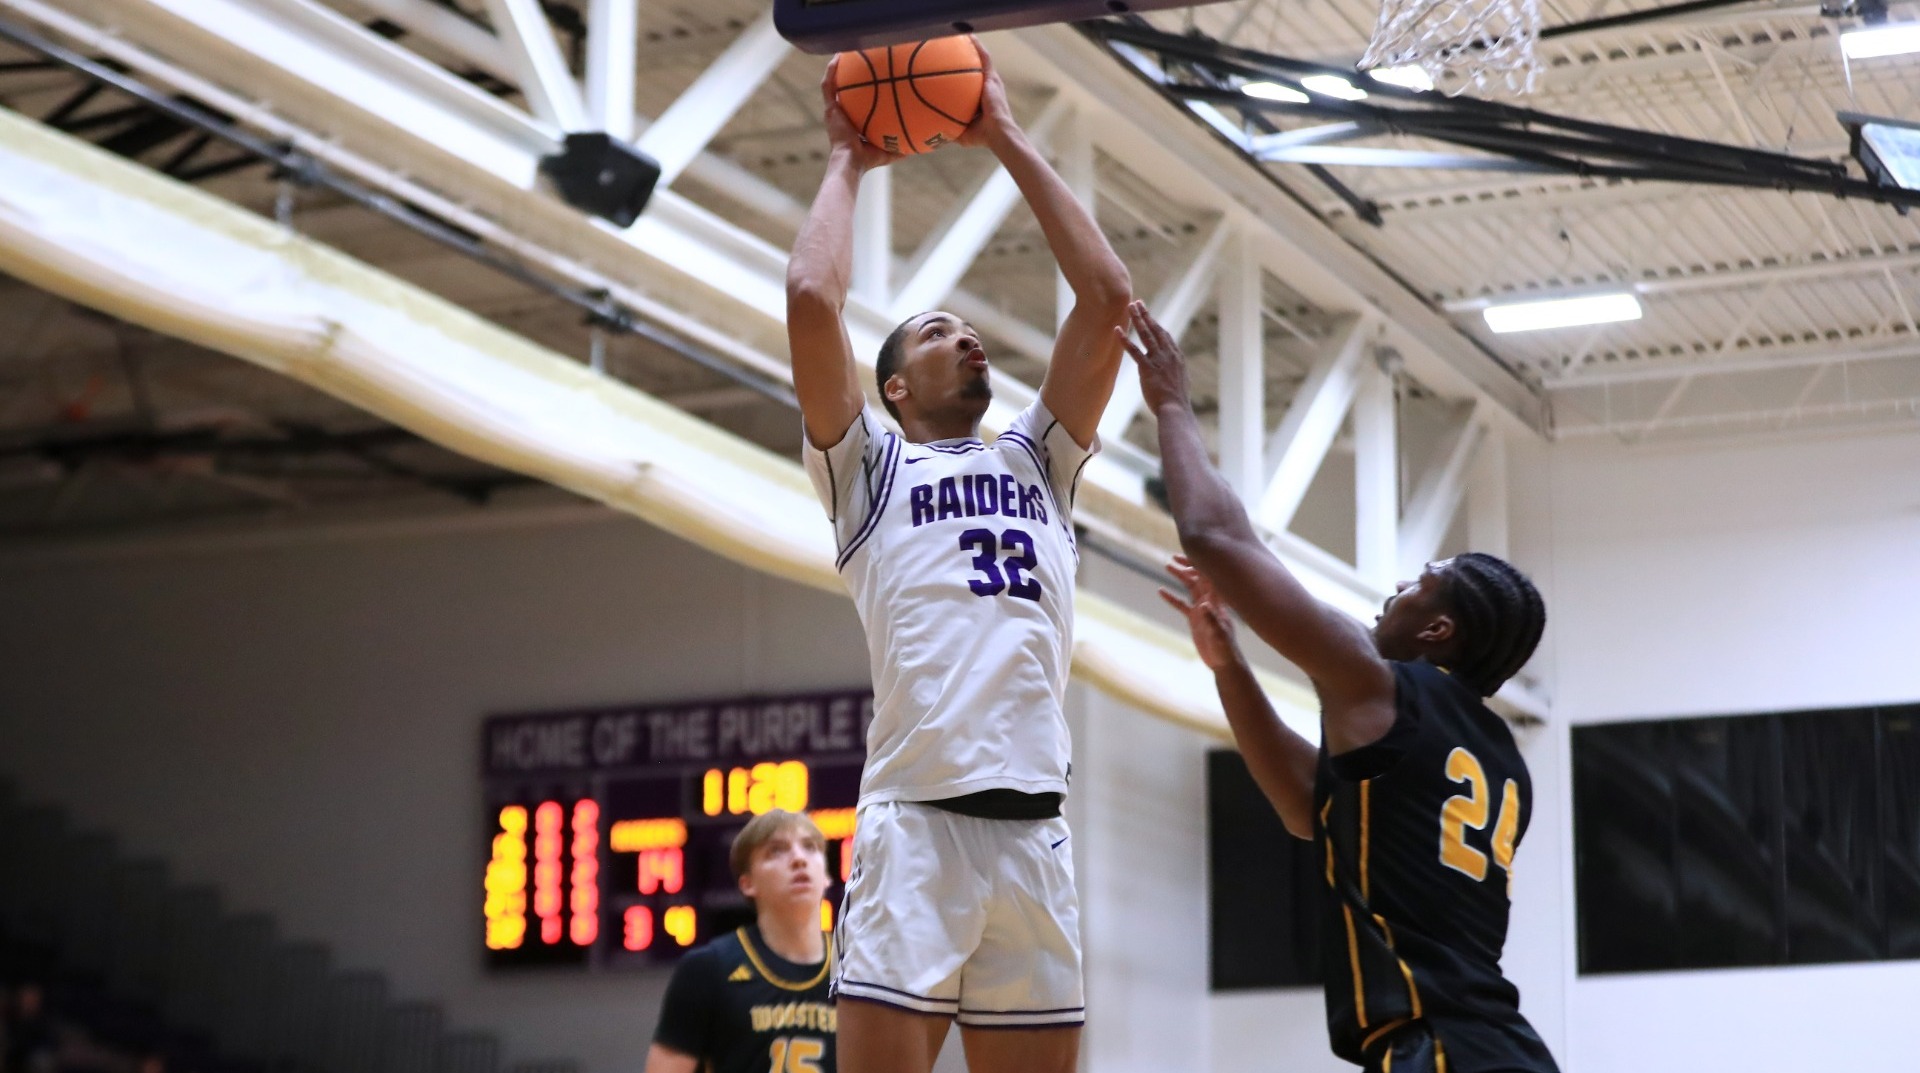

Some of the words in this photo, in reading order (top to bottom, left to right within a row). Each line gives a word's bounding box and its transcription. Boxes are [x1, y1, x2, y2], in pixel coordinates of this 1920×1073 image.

[910, 473, 1048, 527] RAIDERS
[958, 528, 1042, 602] 32
[492, 718, 586, 769] HOME
[593, 716, 638, 763] OF
[647, 709, 709, 759] THE
[718, 699, 852, 755] PURPLE
